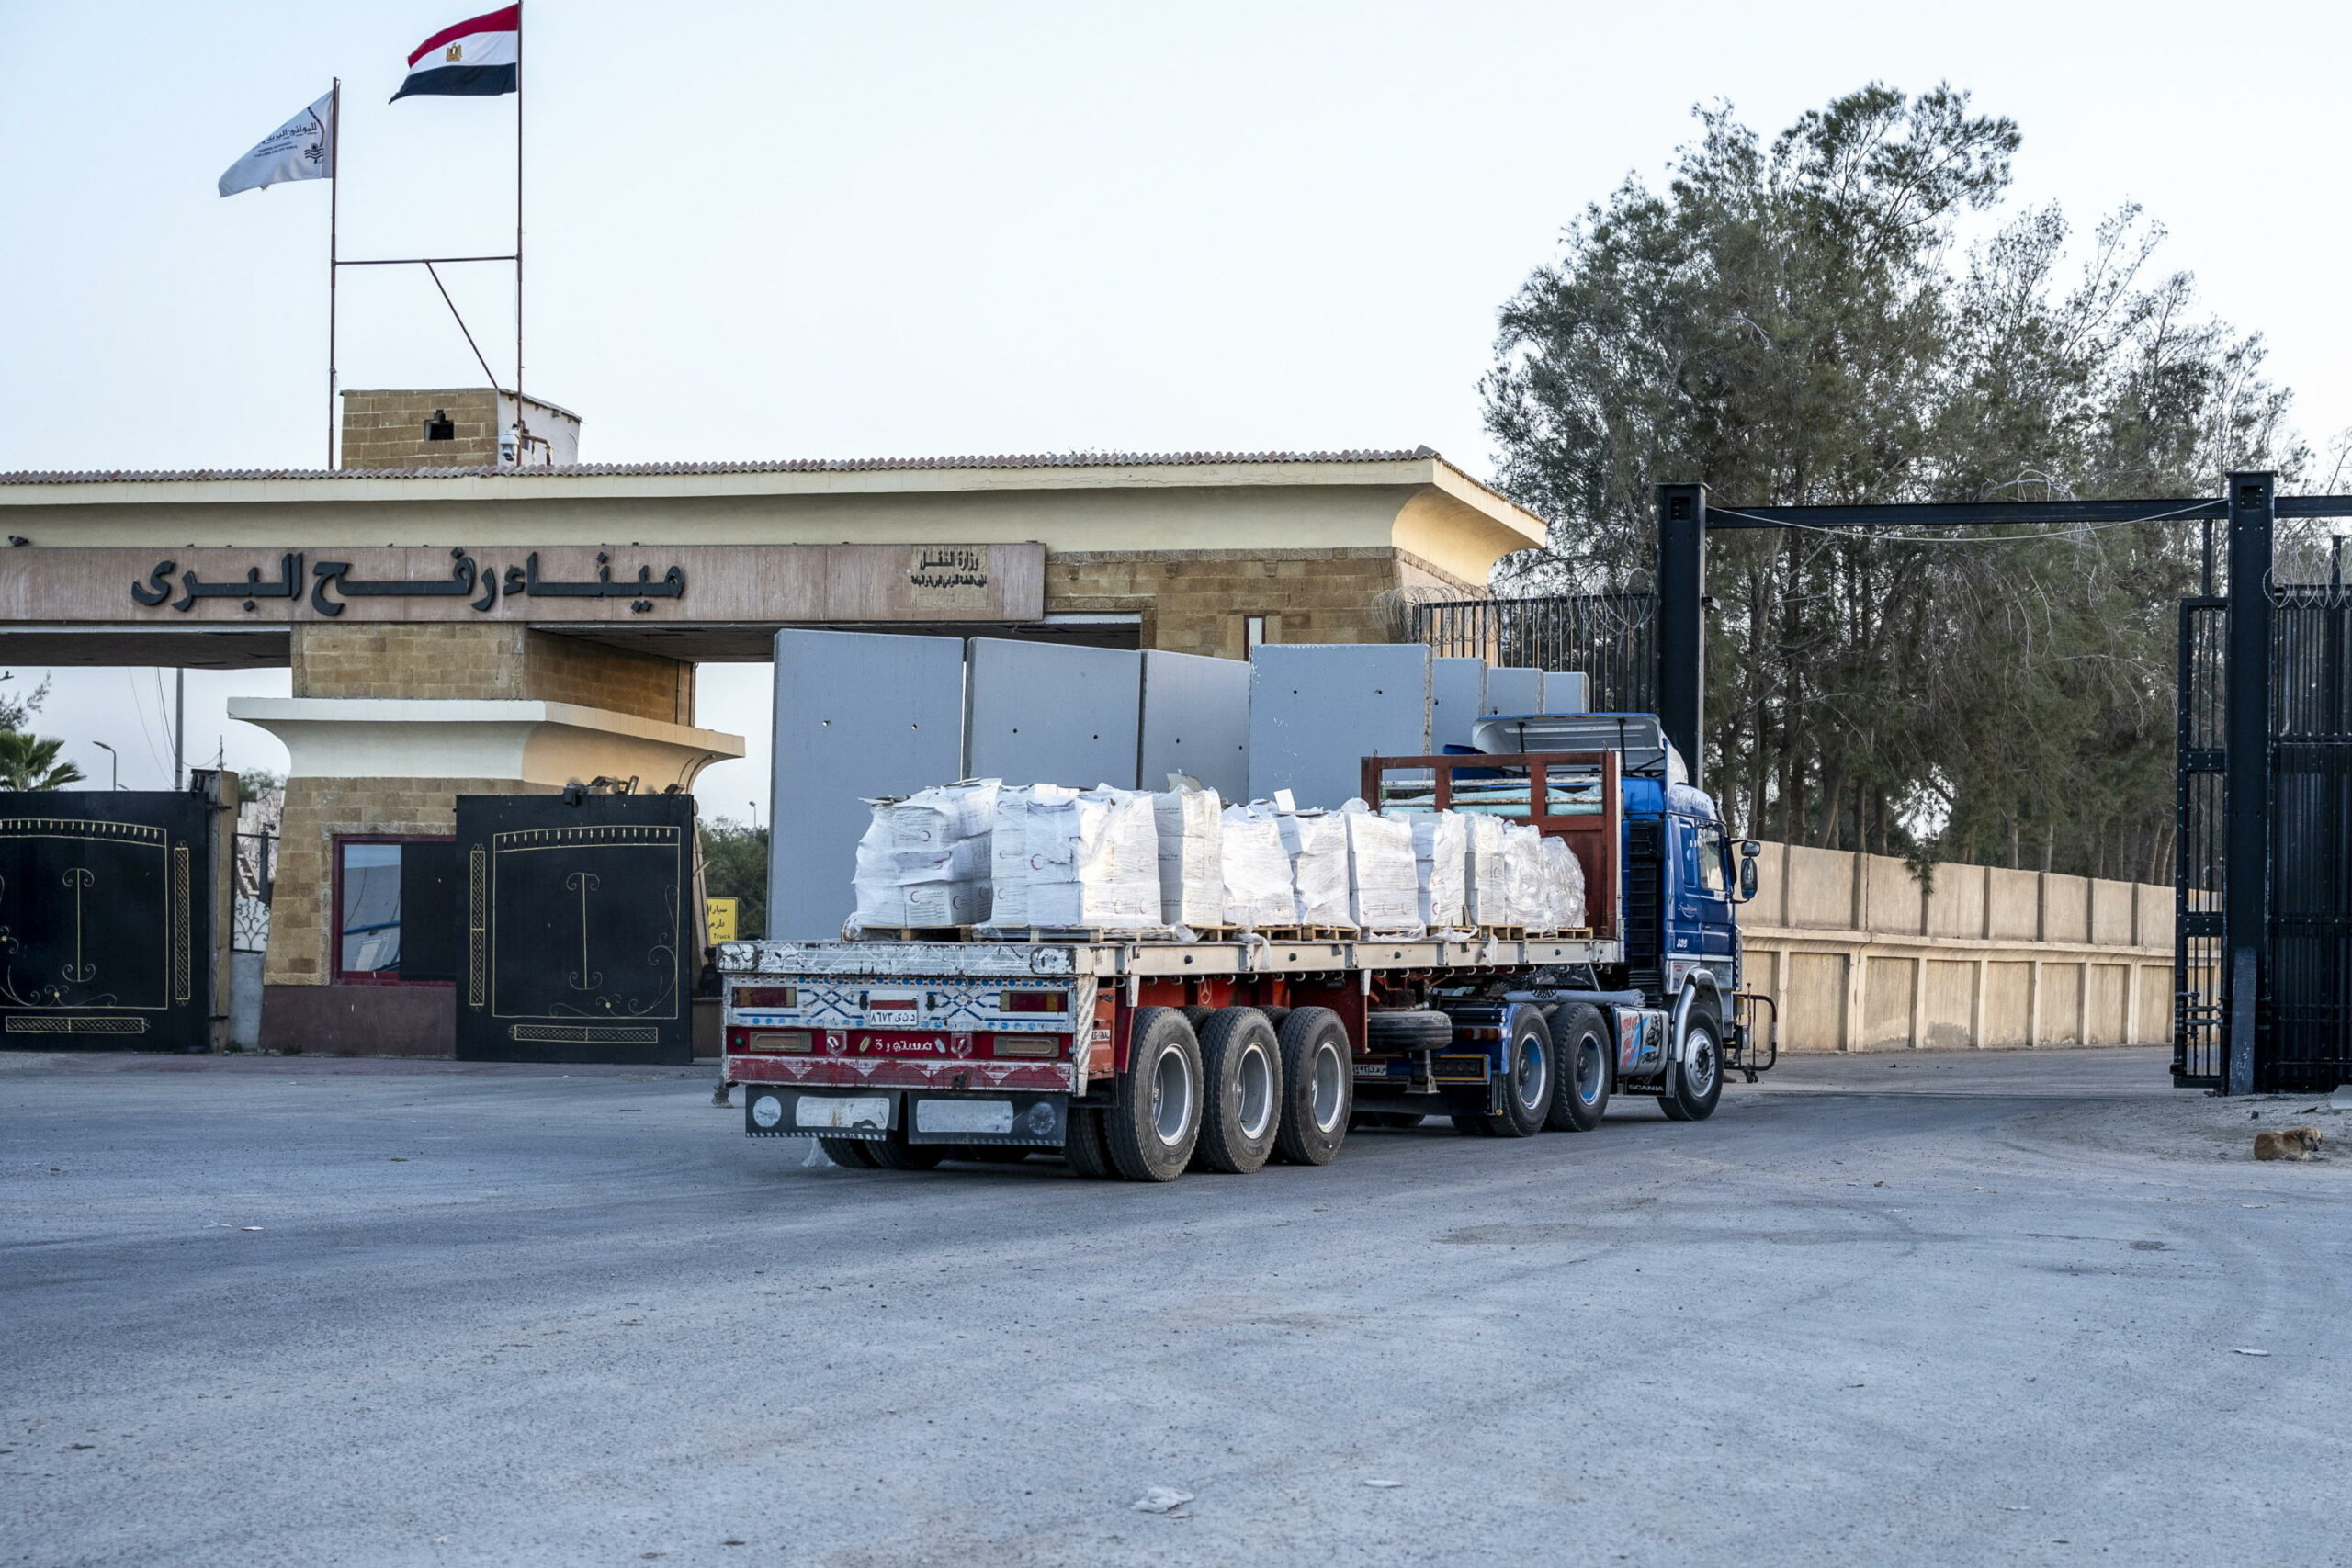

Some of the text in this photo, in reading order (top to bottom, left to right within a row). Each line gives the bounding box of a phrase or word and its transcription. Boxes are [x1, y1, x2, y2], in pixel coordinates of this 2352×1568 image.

[920, 550, 979, 571] وزارة النقل
[312, 547, 497, 616] رفح
[503, 550, 686, 615] ميناء
[709, 905, 728, 914] سيارا
[875, 1038, 933, 1053] مستورة
[1628, 1084, 1665, 1092] SCANIA
